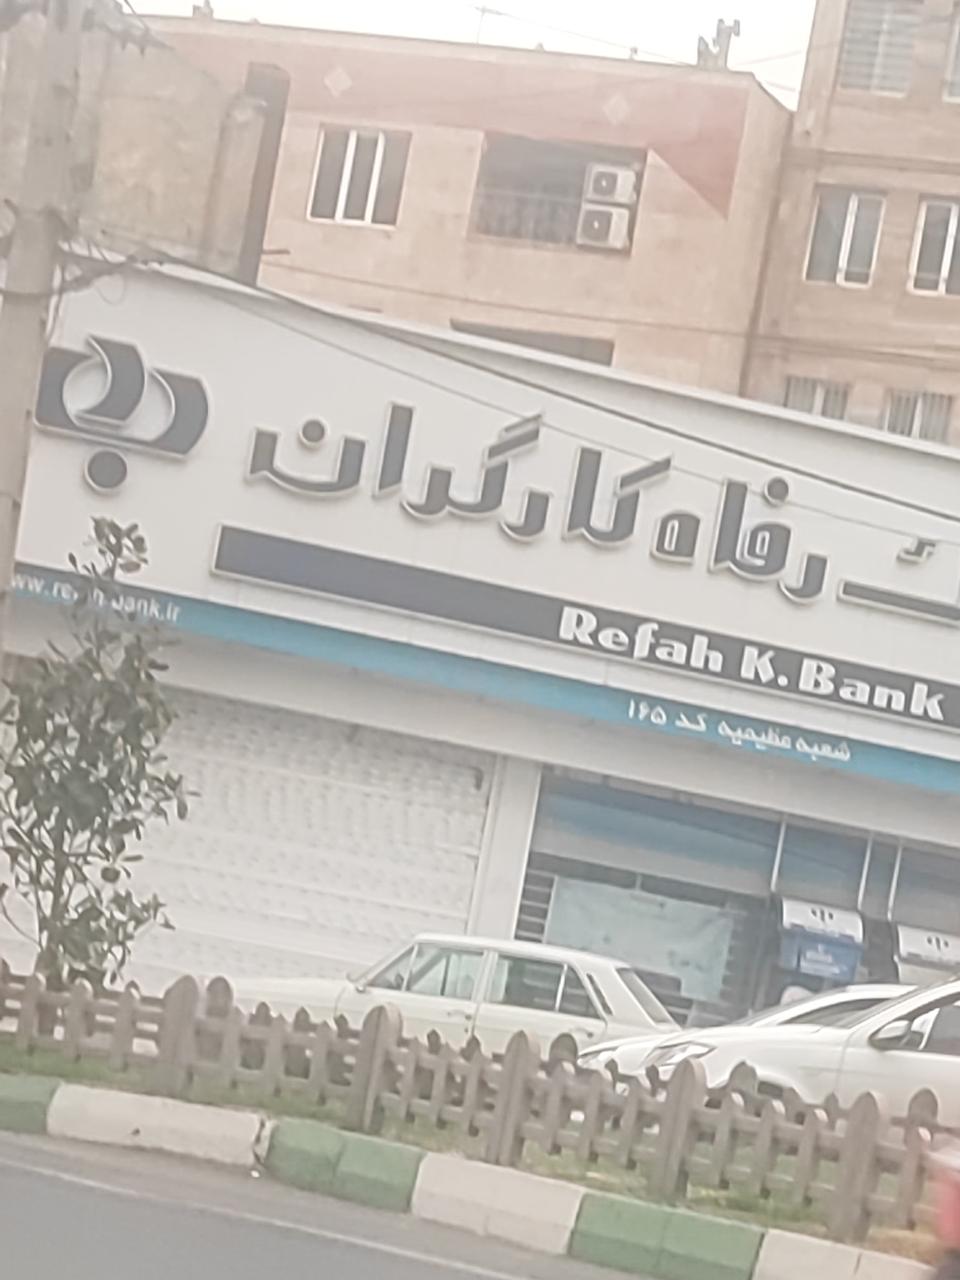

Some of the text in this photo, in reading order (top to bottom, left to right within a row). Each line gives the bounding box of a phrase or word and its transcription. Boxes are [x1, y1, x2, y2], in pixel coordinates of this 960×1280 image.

[246, 401, 672, 546] کارگران
[650, 476, 829, 602] رفاه
[558, 606, 723, 672] Refah
[675, 711, 708, 733] کد
[717, 719, 792, 750] عظیمیه
[795, 740, 851, 762] شعبه
